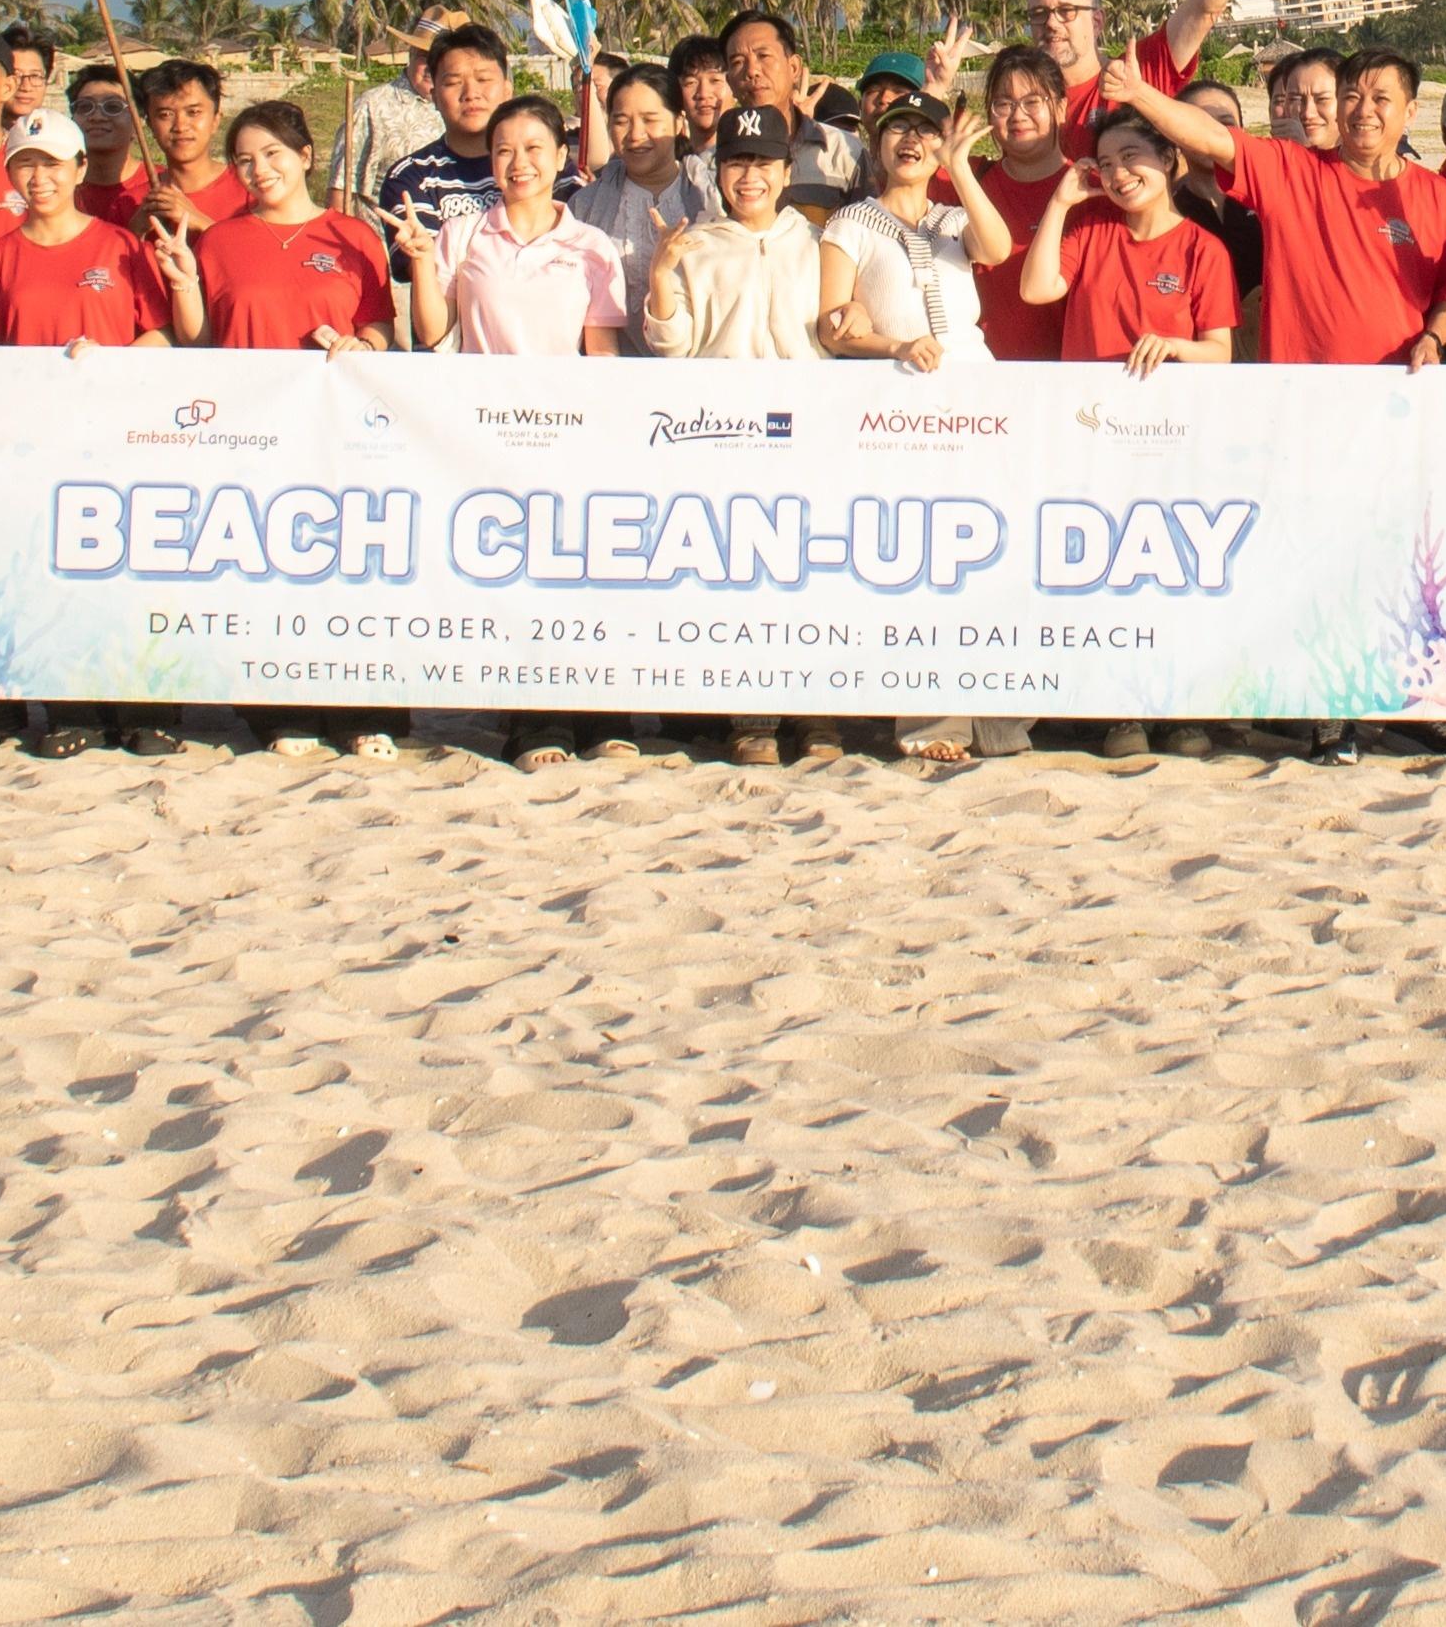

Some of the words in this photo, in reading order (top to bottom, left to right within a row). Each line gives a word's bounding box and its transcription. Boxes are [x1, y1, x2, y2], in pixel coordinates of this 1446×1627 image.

[737, 109, 762, 136] NY
[475, 408, 510, 425] THE
[513, 408, 584, 426] WESTIN
[649, 406, 764, 446] Radisson
[767, 421, 791, 431] BLU
[859, 409, 1009, 435] MÖVENPICK
[1105, 416, 1191, 437] Swandor
[858, 441, 899, 451] RESORT
[903, 442, 929, 452] CAM
[51, 483, 420, 585] BEACH
[448, 486, 1010, 594] CLEAN-UP
[1036, 497, 1261, 597] DAY
[149, 611, 252, 637] DATE:
[274, 613, 307, 637] 10
[326, 614, 511, 642] OCTOBER,
[530, 619, 608, 642] 2026
[657, 621, 863, 647] LOCATION:
[883, 624, 937, 647] BAI
[959, 625, 1017, 648] DAI
[1040, 625, 1155, 650] BEACH
[241, 660, 406, 684] TOGETHER,
[420, 662, 463, 683] WE
[481, 664, 615, 685] PRESERVE
[632, 666, 685, 687] THE
[703, 669, 814, 688] BEAUTY
[829, 670, 866, 689] OF
[881, 670, 941, 690] OUR
[957, 671, 1061, 691] OCEAN
